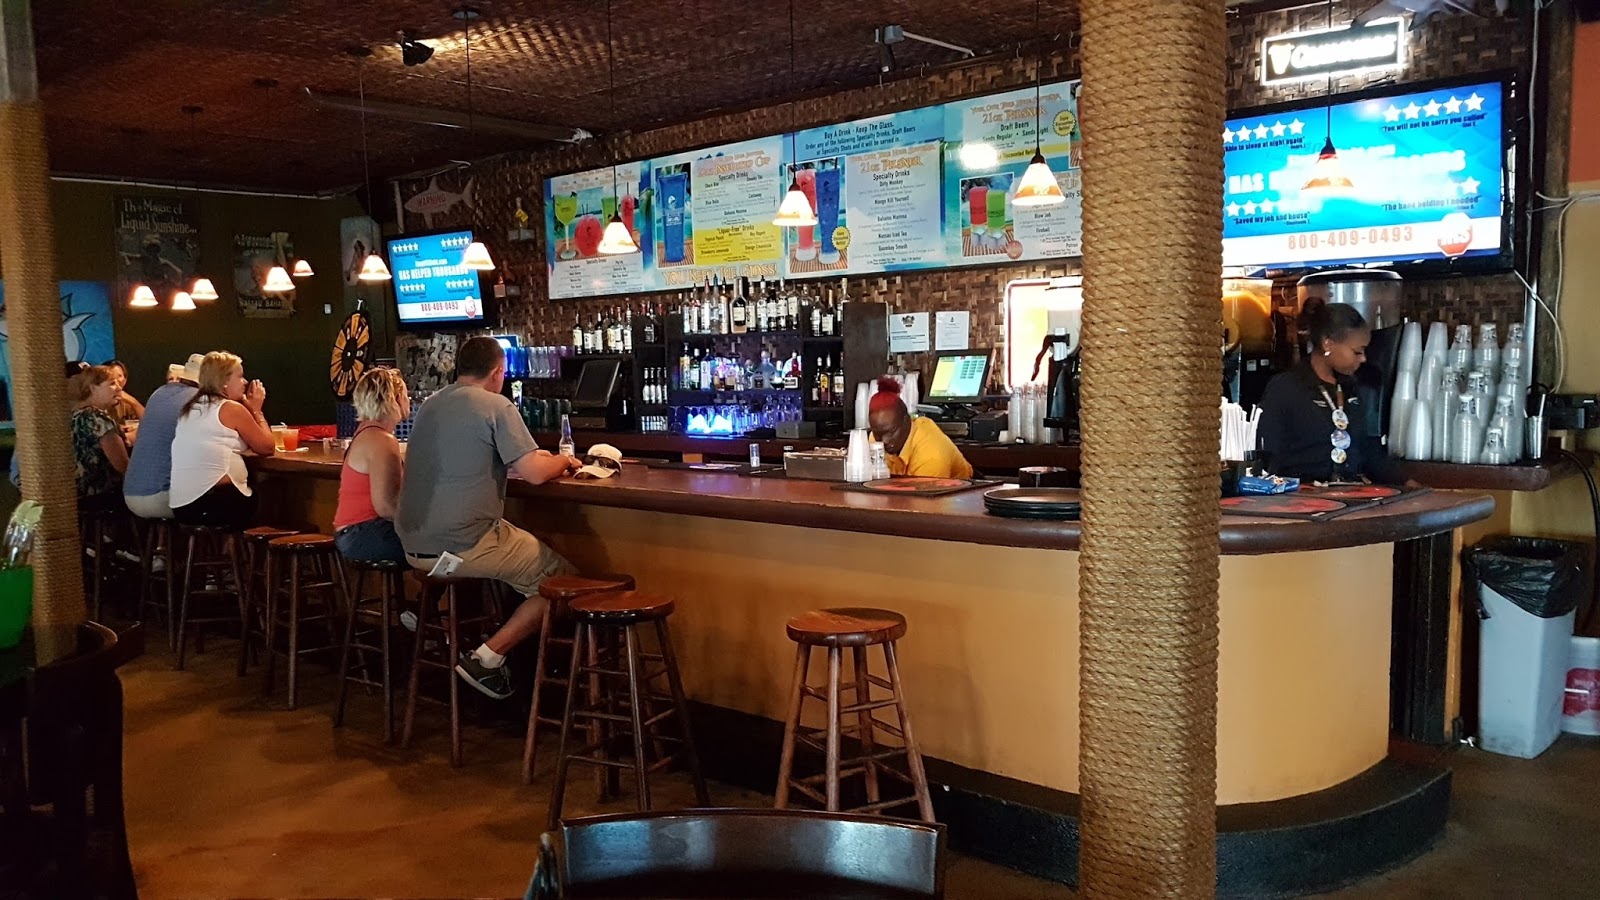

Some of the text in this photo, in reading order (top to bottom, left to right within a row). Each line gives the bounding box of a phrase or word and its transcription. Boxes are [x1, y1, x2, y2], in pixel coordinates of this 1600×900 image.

[824, 131, 833, 140] Buy
[838, 128, 851, 137] Drink
[856, 124, 868, 134] Keep
[869, 123, 878, 131] The
[879, 121, 894, 129] Glass.
[1000, 122, 1014, 131] Draft
[1397, 123, 1408, 131] will
[1431, 119, 1448, 127] sorry
[806, 142, 816, 150] Order
[838, 135, 856, 145] following
[856, 132, 875, 142] Specialty
[892, 127, 902, 135] Draft
[996, 132, 1013, 141] Regular
[1038, 127, 1048, 136] ight
[822, 146, 840, 156] Specialty
[880, 137, 893, 145] served
[1246, 142, 1262, 150] sleep
[1270, 139, 1284, 147] night
[719, 171, 748, 182] Specialty Drinks
[873, 170, 910, 181] Specialty Drinks
[123, 198, 182, 214] The Magic of
[121, 211, 150, 233] Liquid
[1264, 214, 1274, 222] job
[1288, 226, 1412, 250] 800-409-0493
